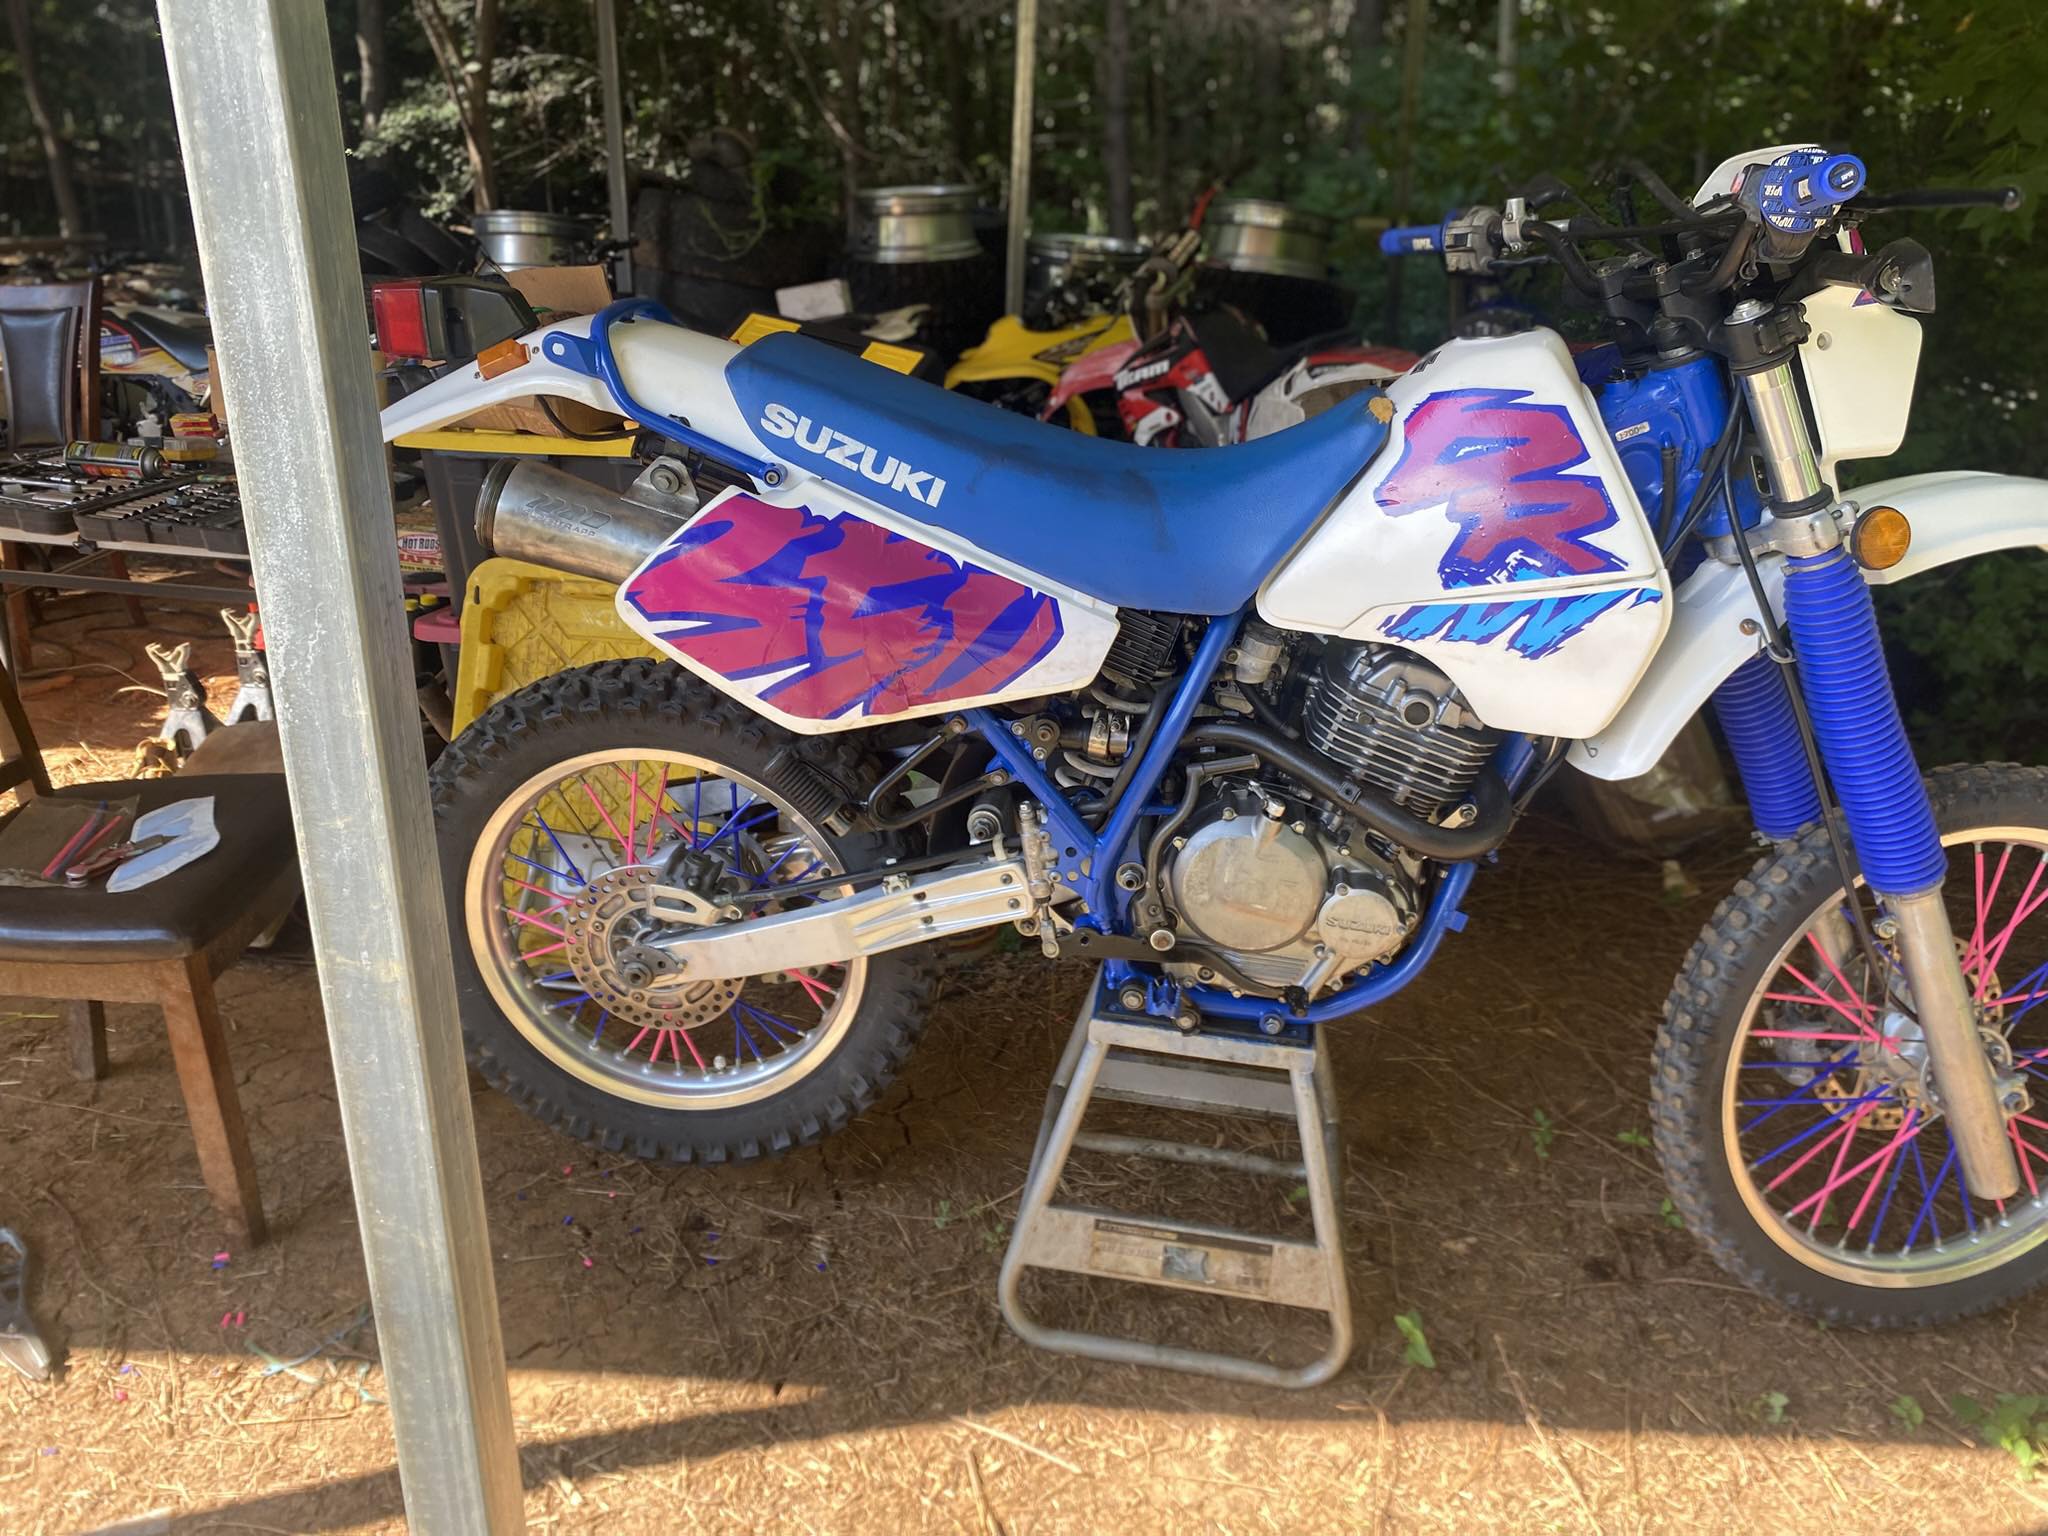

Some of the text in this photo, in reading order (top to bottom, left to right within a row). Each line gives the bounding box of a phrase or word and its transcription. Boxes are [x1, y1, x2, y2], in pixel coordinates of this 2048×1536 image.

[760, 403, 946, 508] SUZUKI
[402, 537, 418, 549] HOT
[1326, 917, 1391, 936] SUZUKI
